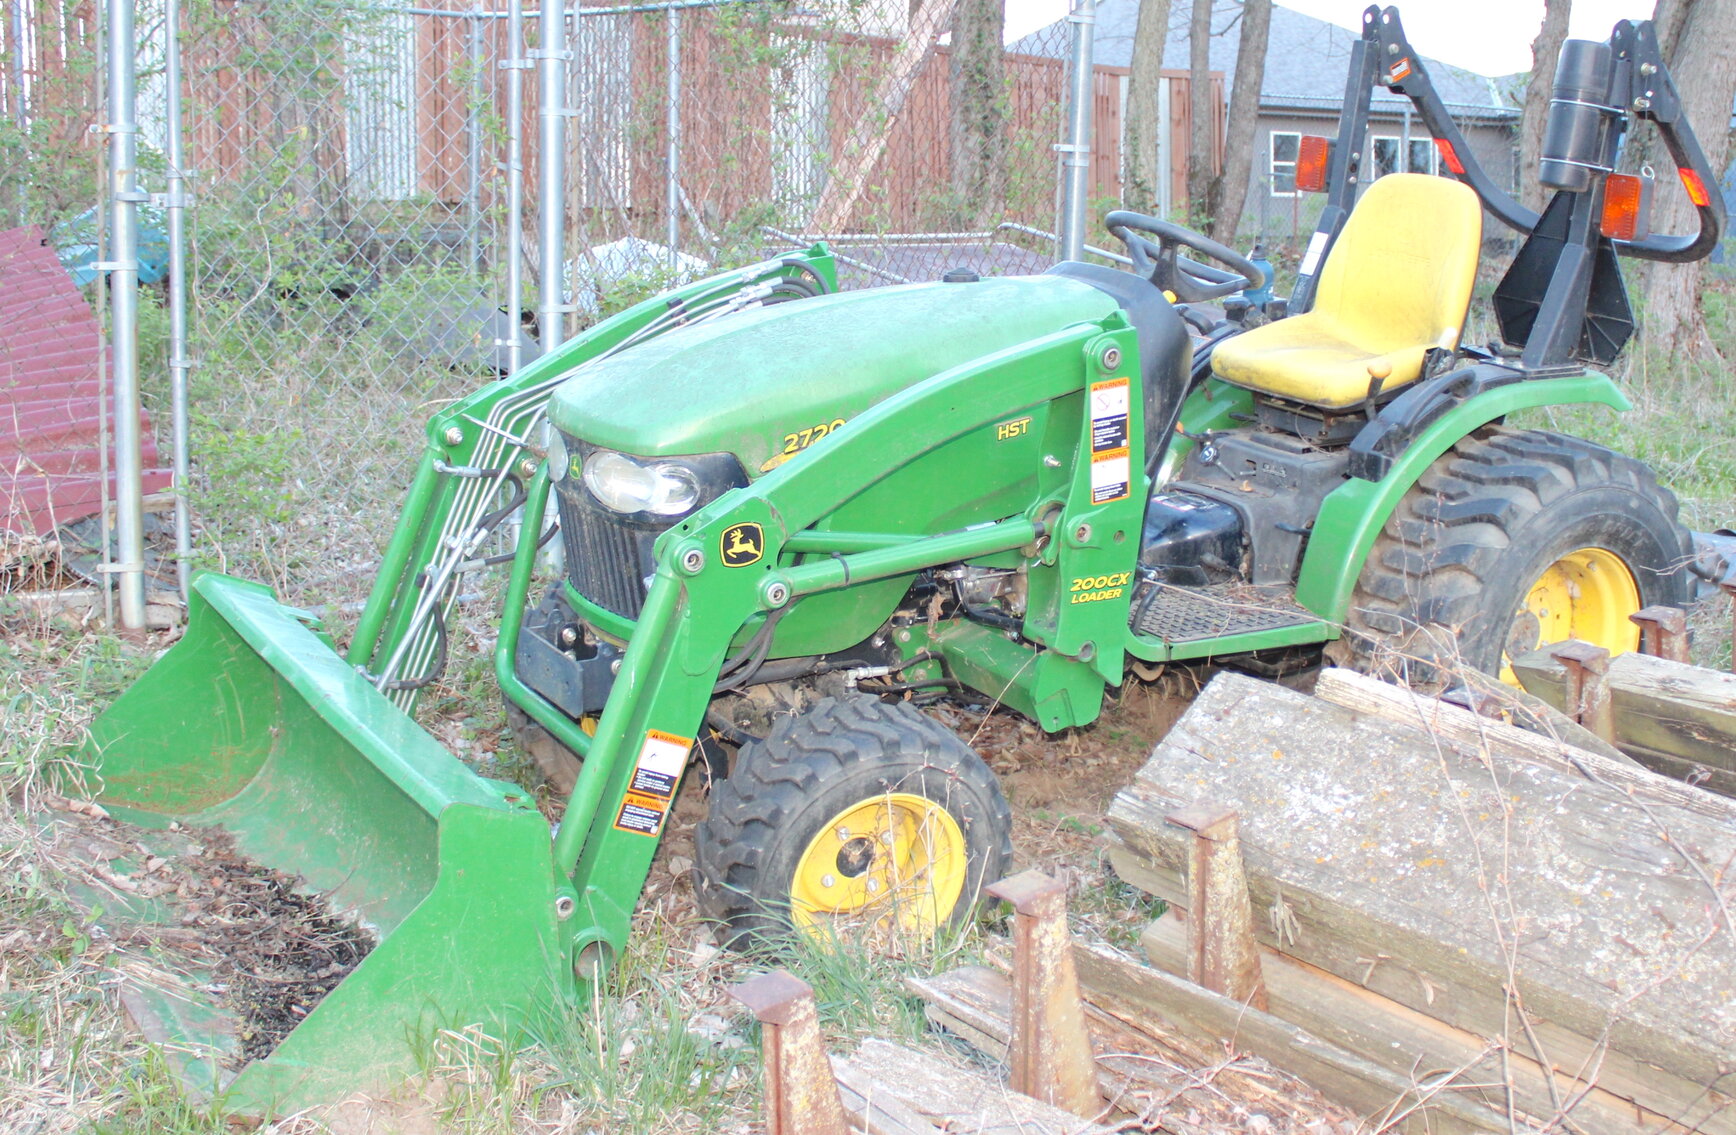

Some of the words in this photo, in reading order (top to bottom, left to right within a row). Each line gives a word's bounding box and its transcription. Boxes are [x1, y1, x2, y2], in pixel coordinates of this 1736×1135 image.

[1099, 378, 1127, 390] WARNING
[998, 418, 1030, 441] HST
[1099, 450, 1127, 462] WARNING
[1070, 571, 1131, 592] 200CX
[1071, 588, 1122, 604] LOADER
